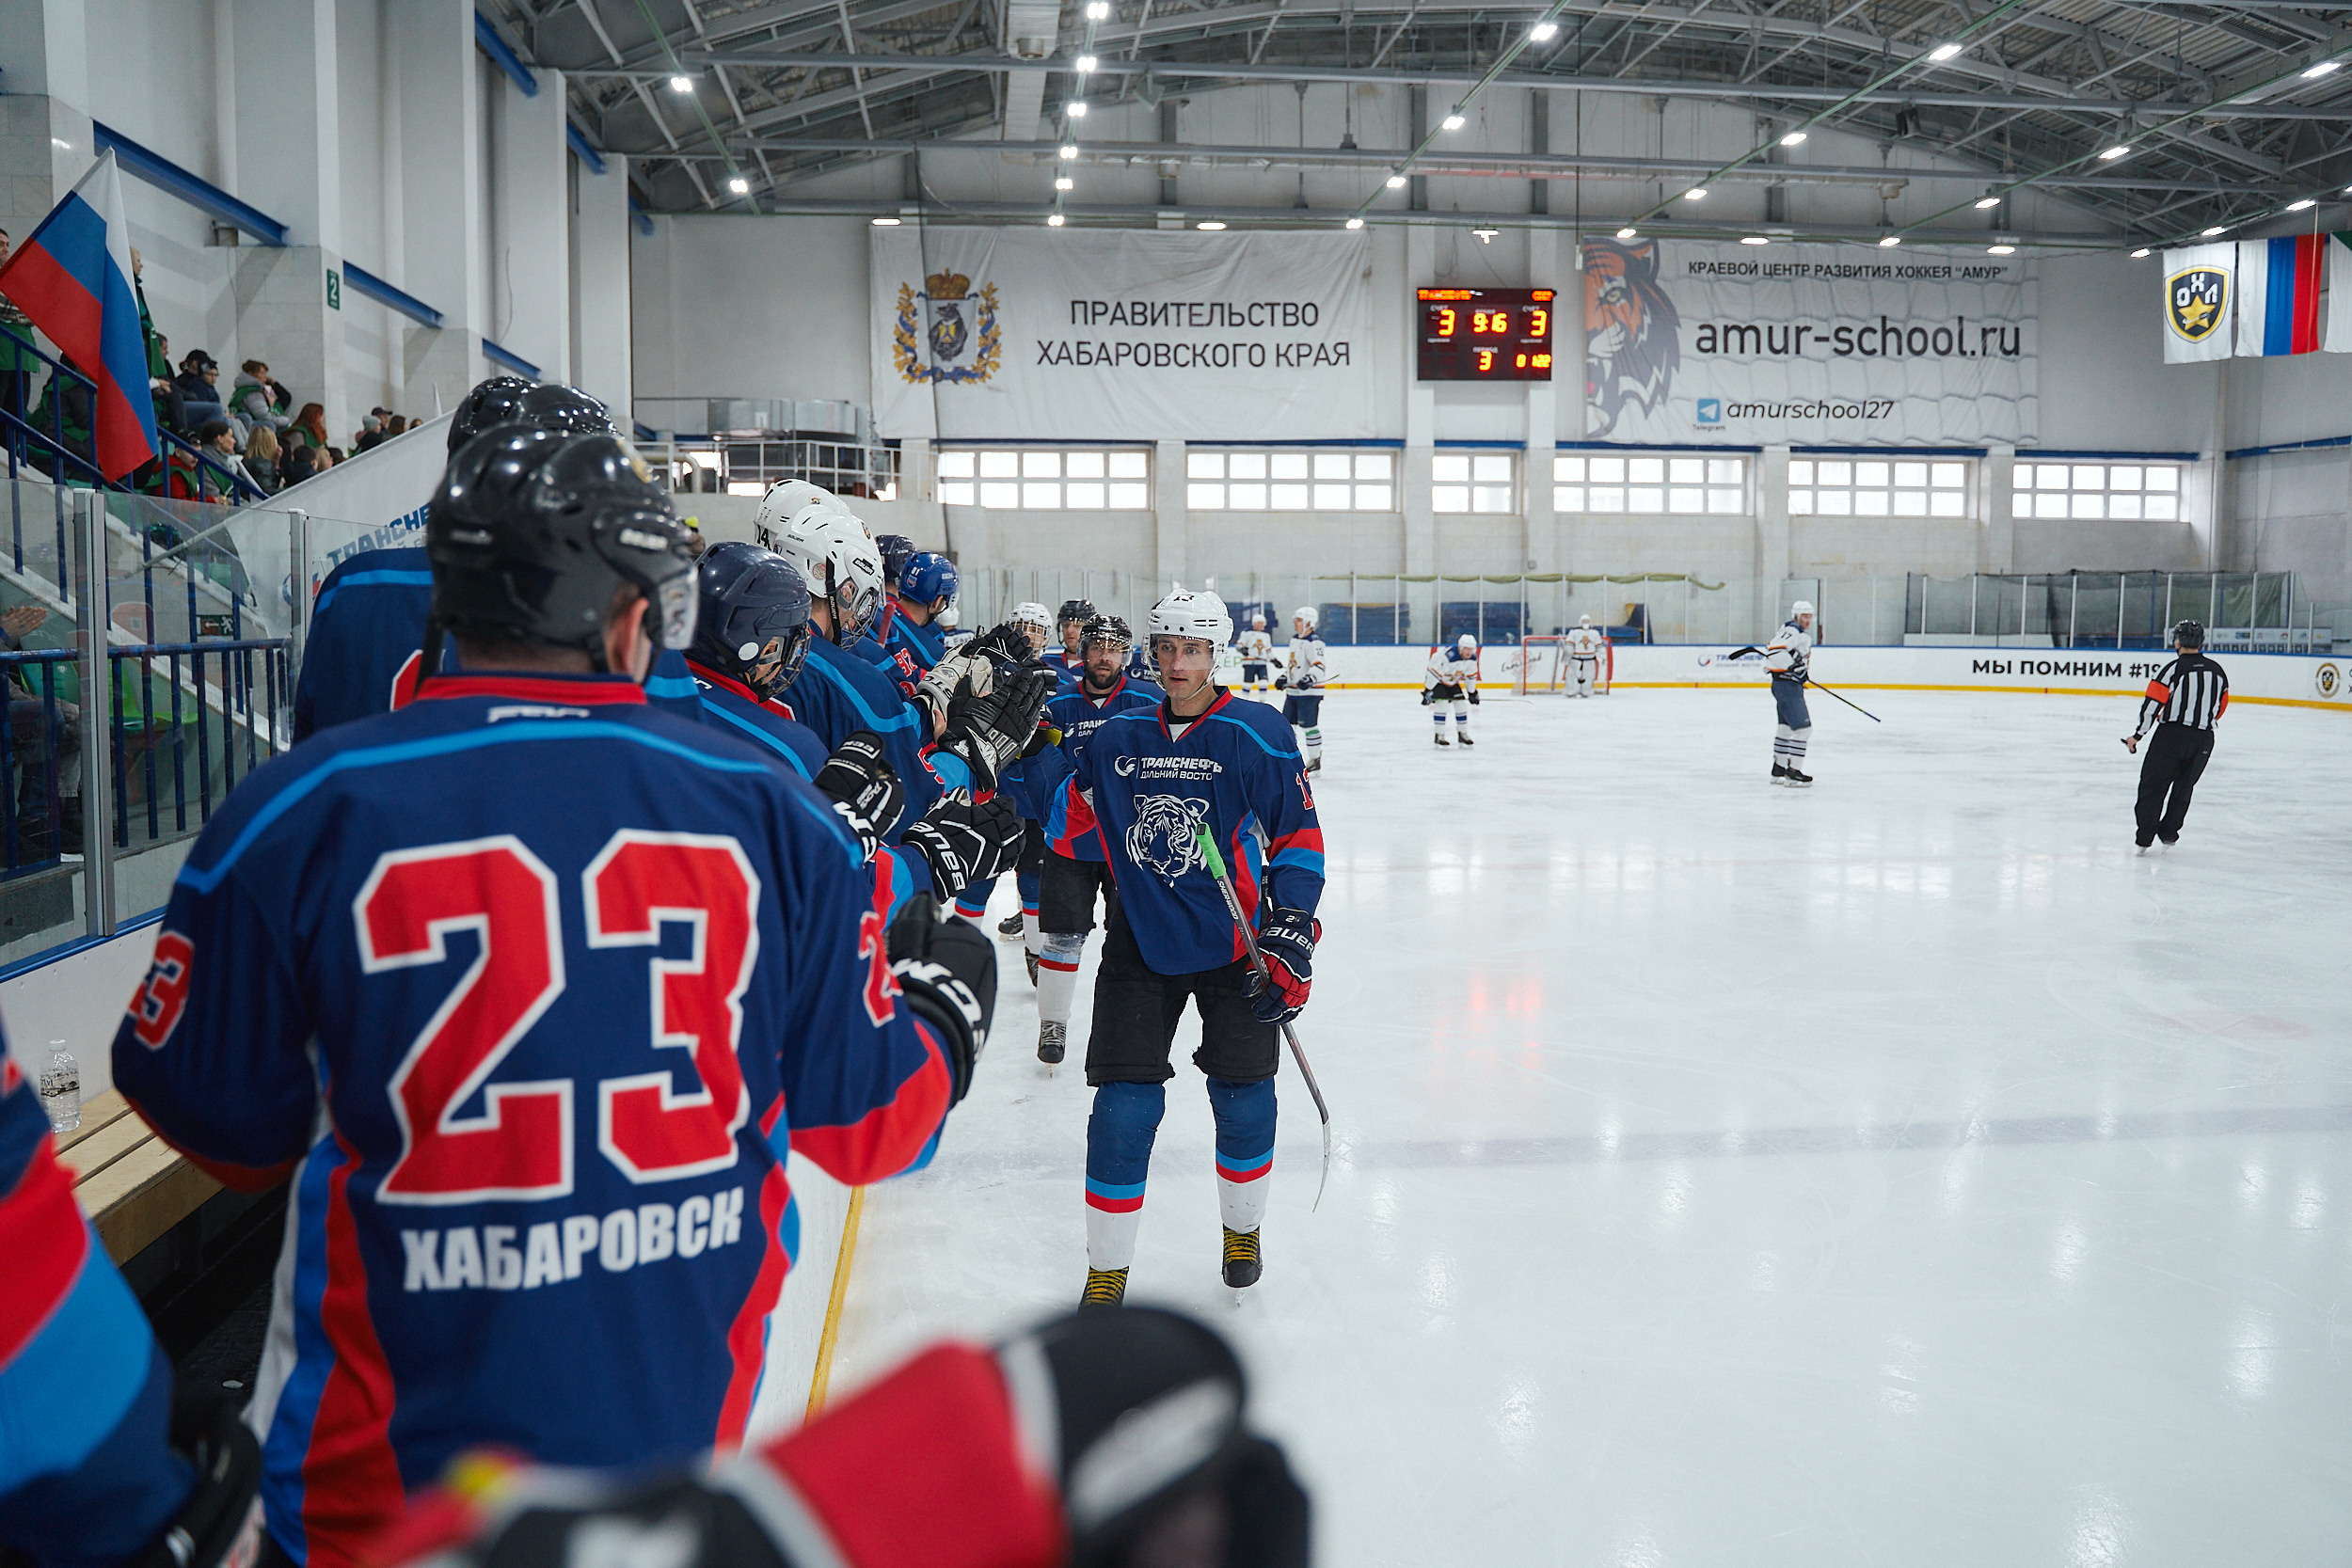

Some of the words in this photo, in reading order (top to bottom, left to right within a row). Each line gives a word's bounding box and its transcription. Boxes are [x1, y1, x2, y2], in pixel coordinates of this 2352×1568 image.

[1689, 261, 1758, 276] КРАЕВОЙ
[1763, 263, 1810, 278] ЦЕНТР
[1814, 265, 1891, 278] РАЗВИТИЯ
[1895, 265, 1951, 278] ХОККЕЯ
[330, 277, 338, 301] 2
[1071, 300, 1319, 326] ПРАВИТЕЛЬСТВО
[1438, 309, 1455, 336] 3
[1530, 309, 1548, 337] 3
[1695, 314, 2020, 357] amur-school.ru
[1037, 340, 1265, 367] ХАБАРОВСКОГО
[1275, 341, 1350, 367] КРАЯ
[1479, 350, 1493, 371] 3
[1727, 400, 1895, 420] amurschool27
[1972, 659, 2011, 674] МЫ
[2020, 660, 2122, 677] ПОМНИМ
[129, 929, 195, 1052] 3
[352, 828, 761, 1206] 23
[401, 1187, 744, 1292] ХАБАРОВСК
